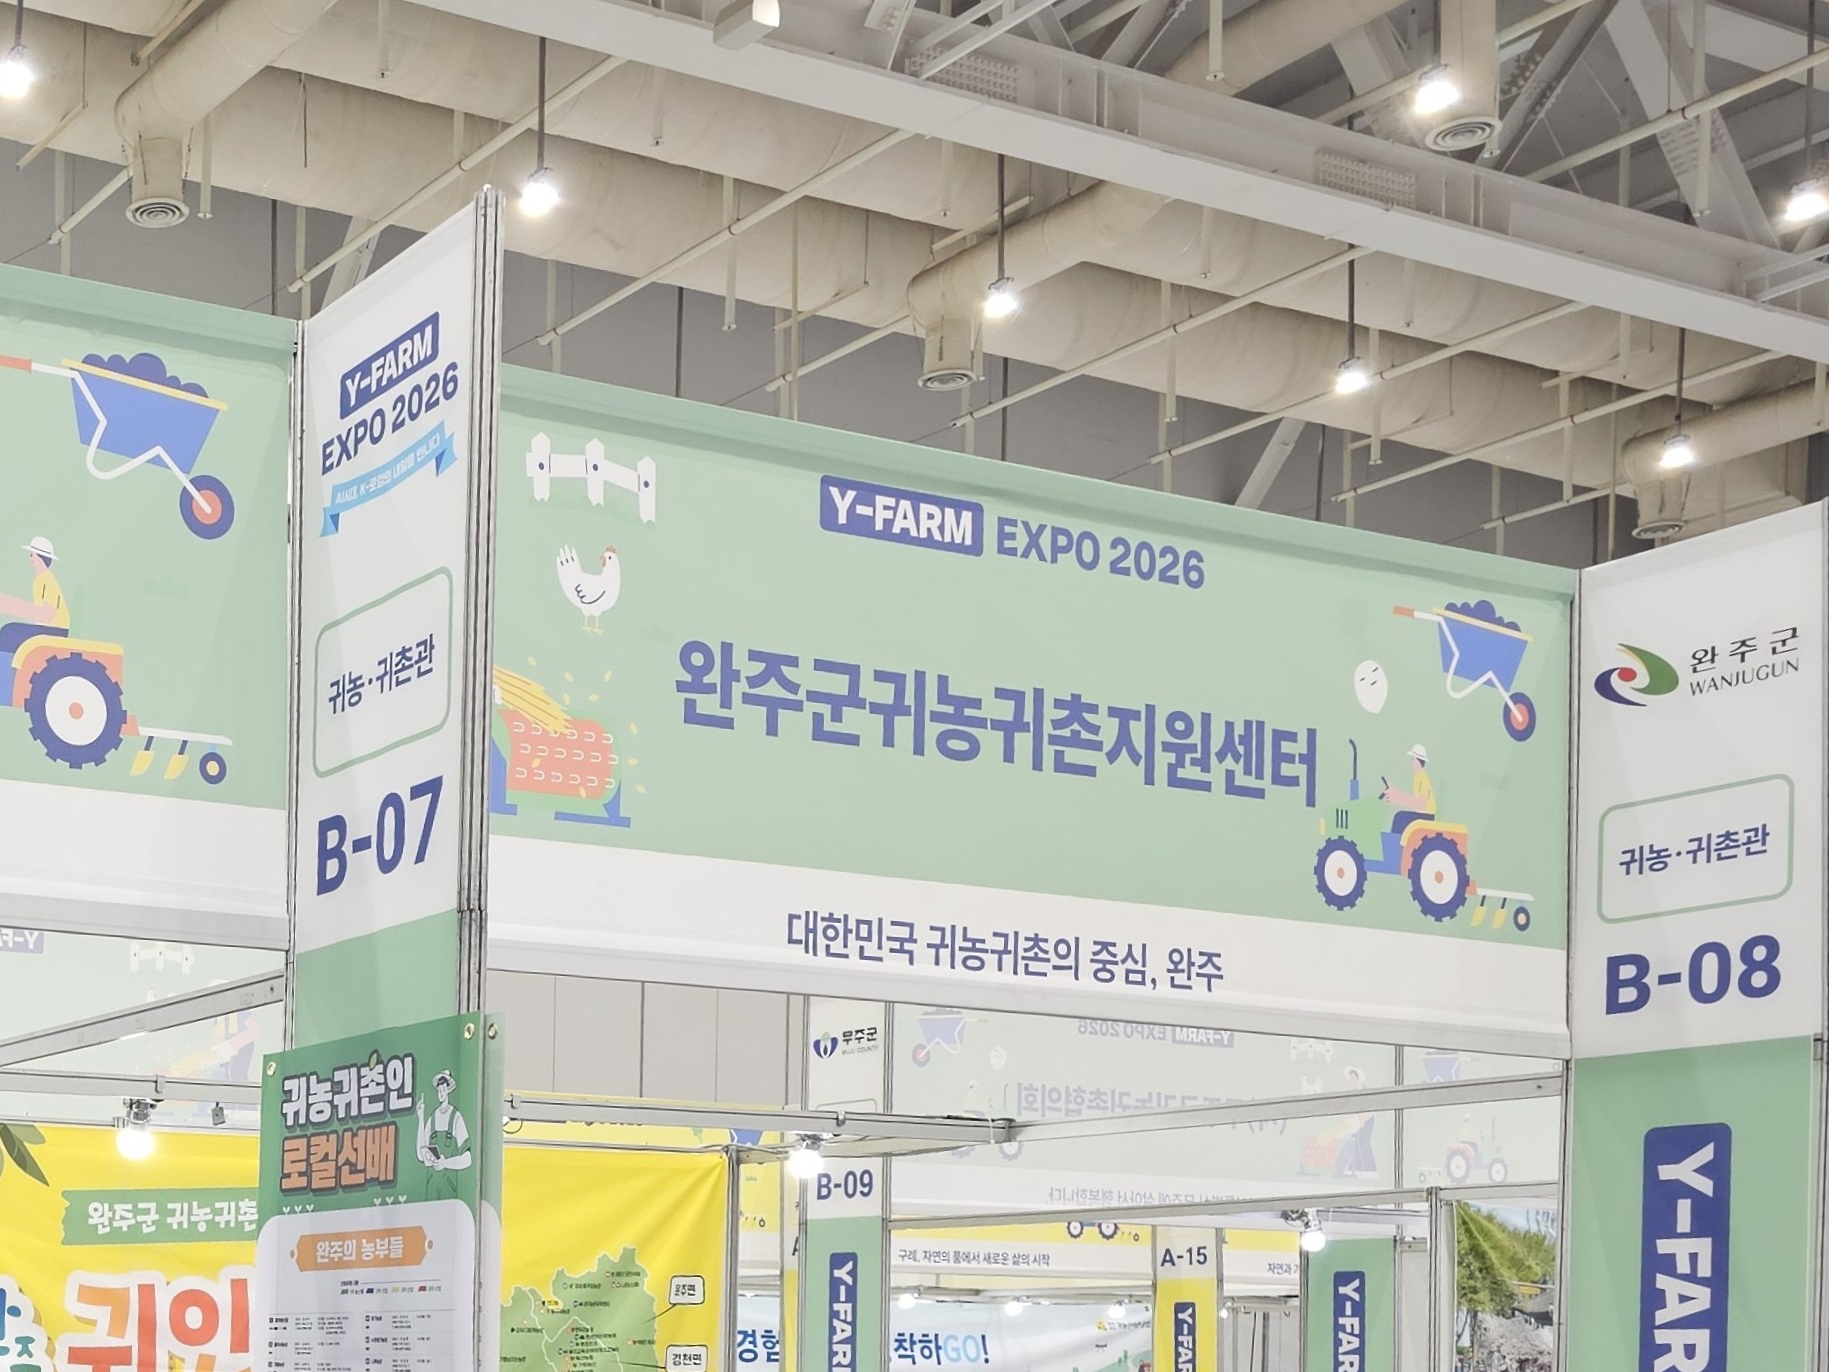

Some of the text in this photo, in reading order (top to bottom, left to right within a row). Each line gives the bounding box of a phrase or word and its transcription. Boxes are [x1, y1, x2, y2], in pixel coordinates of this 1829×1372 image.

[346, 325, 433, 408] Y-FARM
[321, 361, 459, 475] EXPO 2026
[830, 486, 1204, 590] Y-FARM EXPO 2026
[328, 633, 435, 716] 귀농·귀촌관
[1690, 627, 1799, 675] 완주군
[1690, 658, 1799, 697] WANJUGUN
[675, 640, 1316, 808] 완주군귀농귀촌지원센터
[316, 776, 443, 896] B-07
[1619, 824, 1769, 876] 귀농·귀촌관
[787, 912, 1223, 992] 대한민국 귀농귀촌의 중심, 완주
[1605, 935, 1780, 1015] B-08
[842, 1026, 877, 1044] 무주군
[283, 1056, 413, 1127] 귀농귀촌인
[282, 1125, 396, 1190] 로컬선배
[817, 1169, 873, 1200] B-09
[88, 1201, 158, 1233] 완주군
[316, 1237, 403, 1262] 완주의 농부들
[922, 1250, 951, 1264] 자연의
[952, 1251, 981, 1265] 품에서
[982, 1252, 1009, 1266] 새로운
[1031, 1252, 1050, 1266] 시작
[1160, 1247, 1208, 1267] A-15
[889, 1332, 989, 1366] 착하GO!
